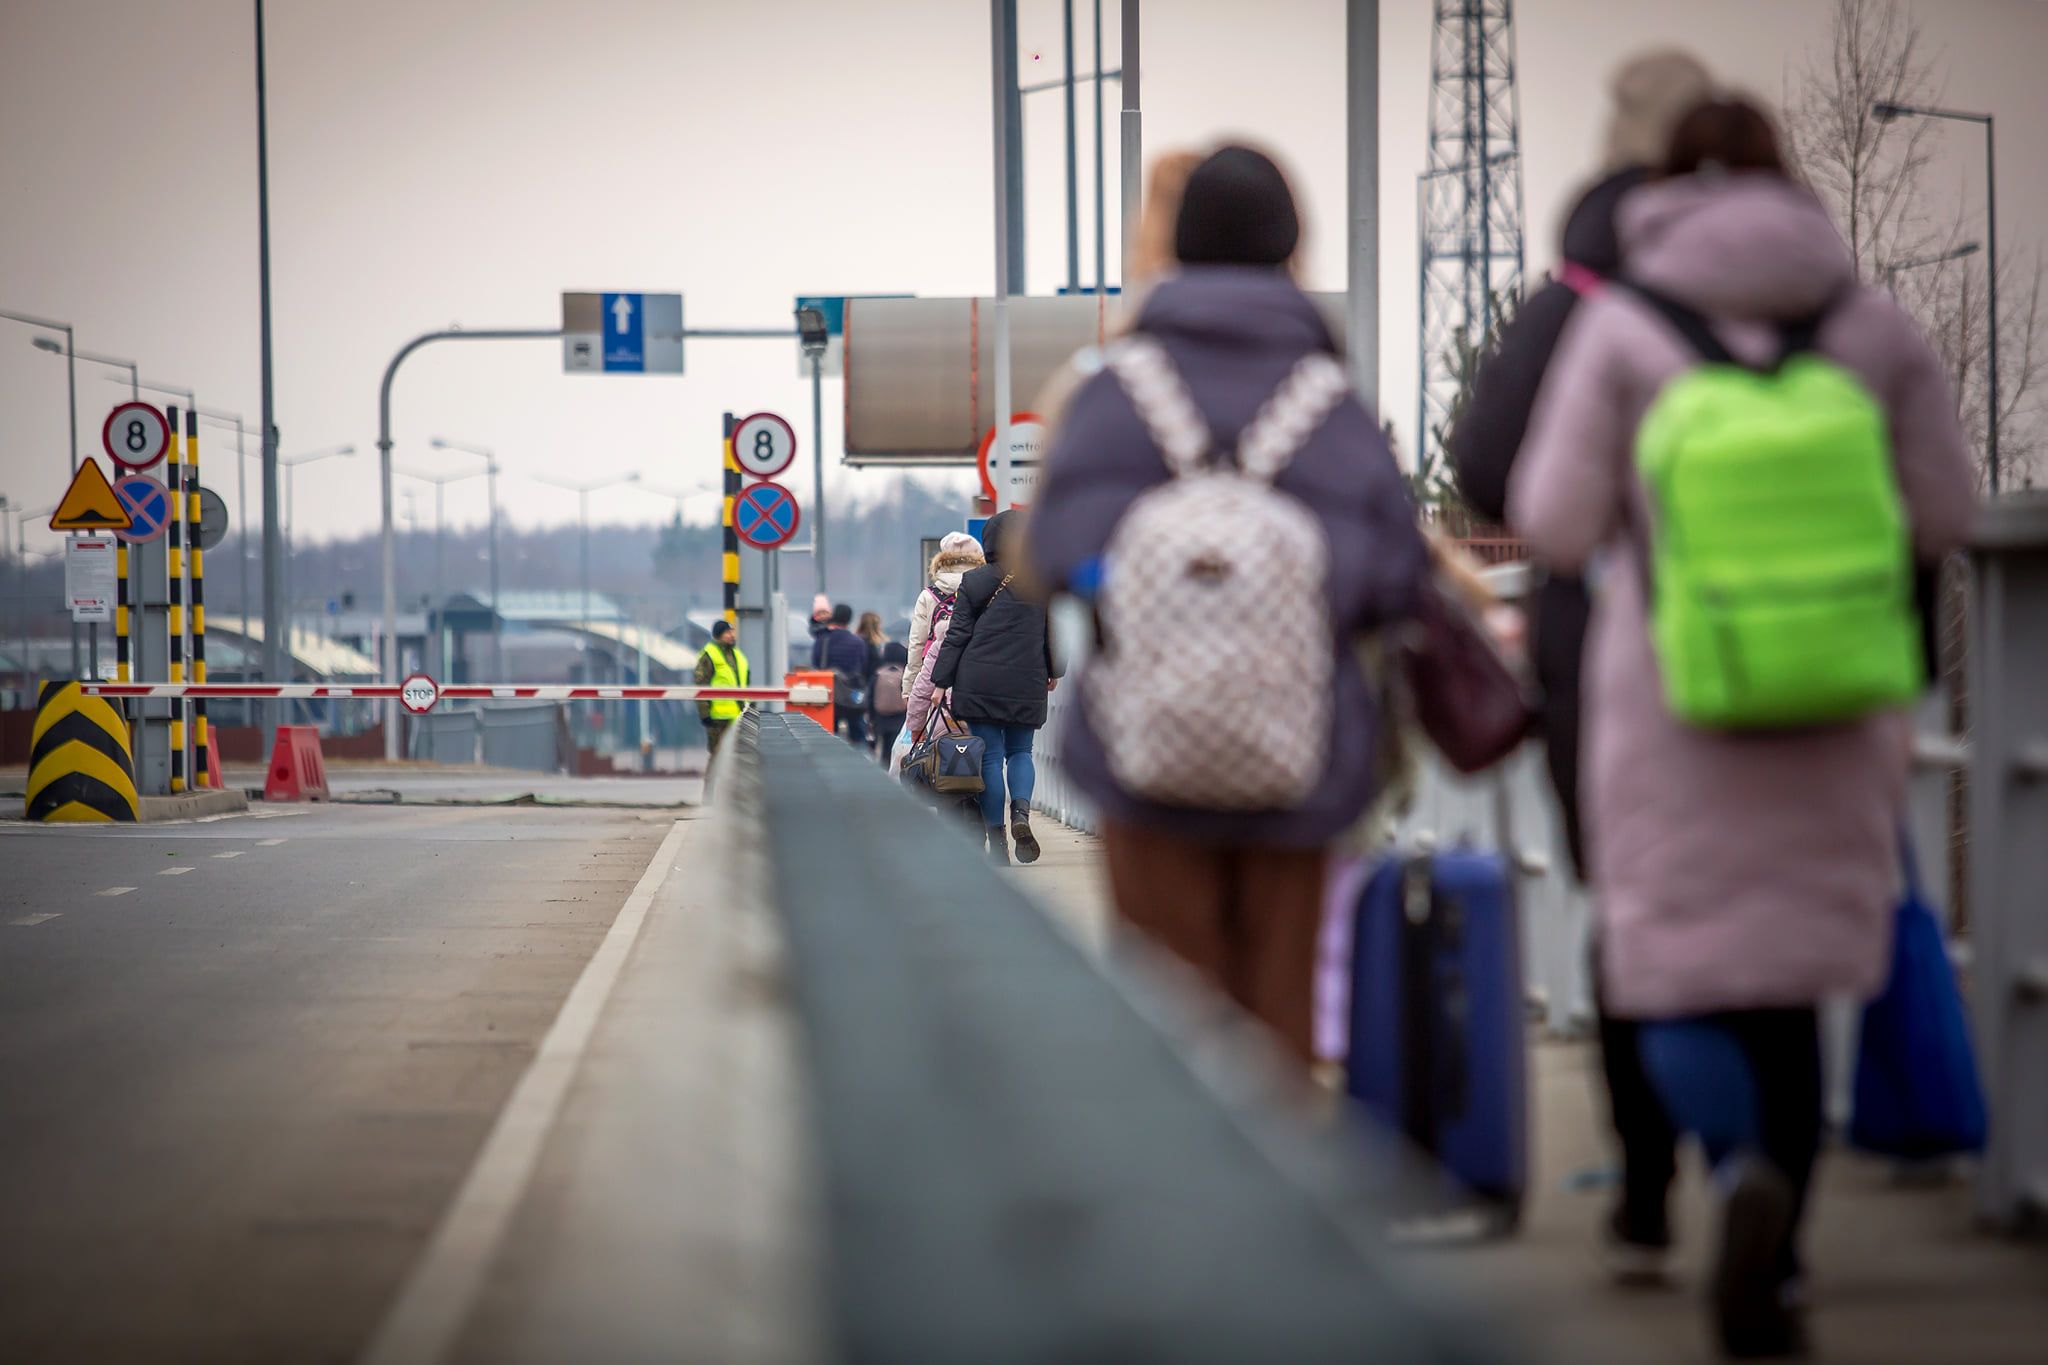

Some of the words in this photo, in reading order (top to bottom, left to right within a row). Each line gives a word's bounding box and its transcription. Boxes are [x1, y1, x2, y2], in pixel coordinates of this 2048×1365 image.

[127, 420, 146, 452] 8
[754, 430, 773, 461] 8
[405, 688, 433, 701] STOP
